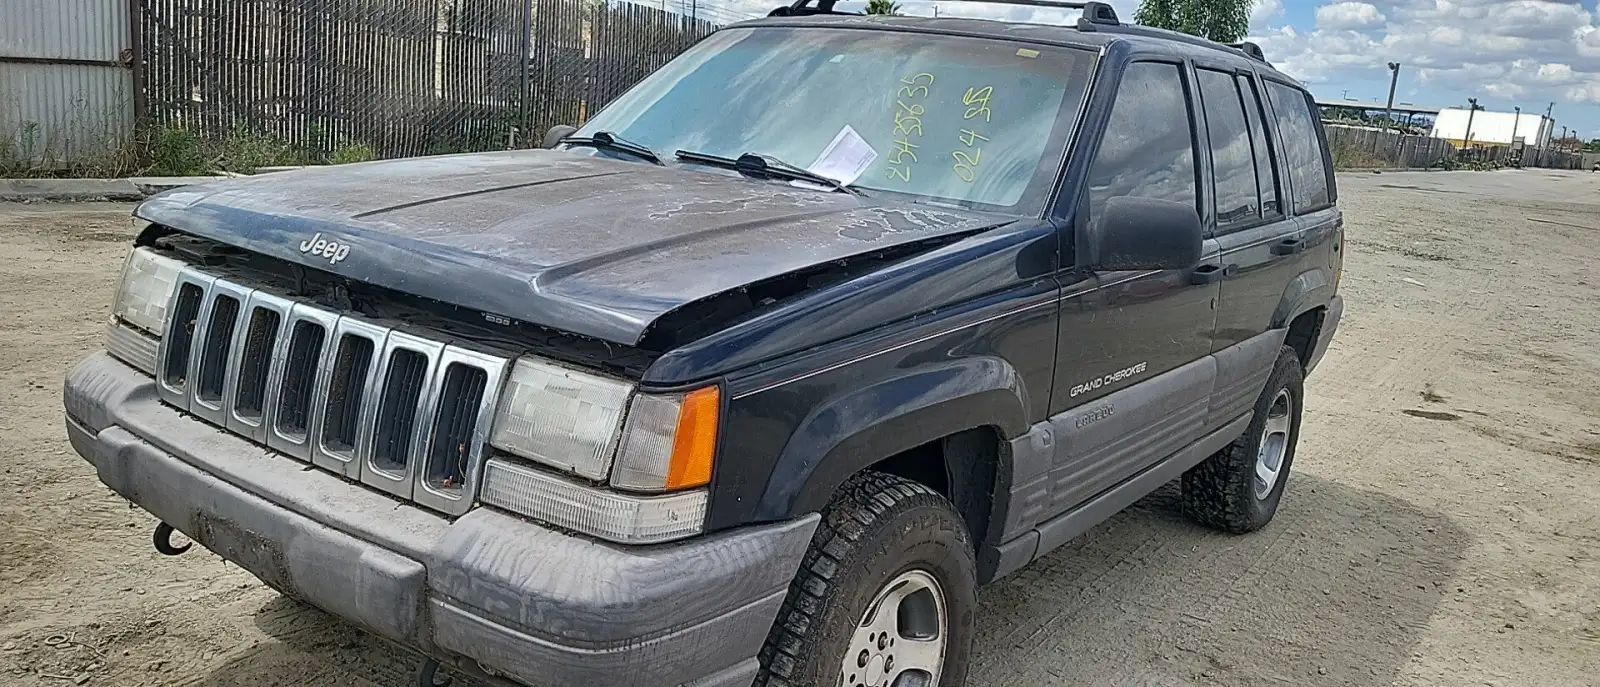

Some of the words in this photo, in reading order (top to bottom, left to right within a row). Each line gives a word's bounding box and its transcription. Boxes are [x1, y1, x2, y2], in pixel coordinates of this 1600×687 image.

[952, 128, 990, 182] 024
[300, 232, 351, 265] Jeep
[1070, 378, 1103, 397] GRAND
[1104, 361, 1147, 385] CHEROKEE
[1075, 404, 1115, 429] LAREDO
